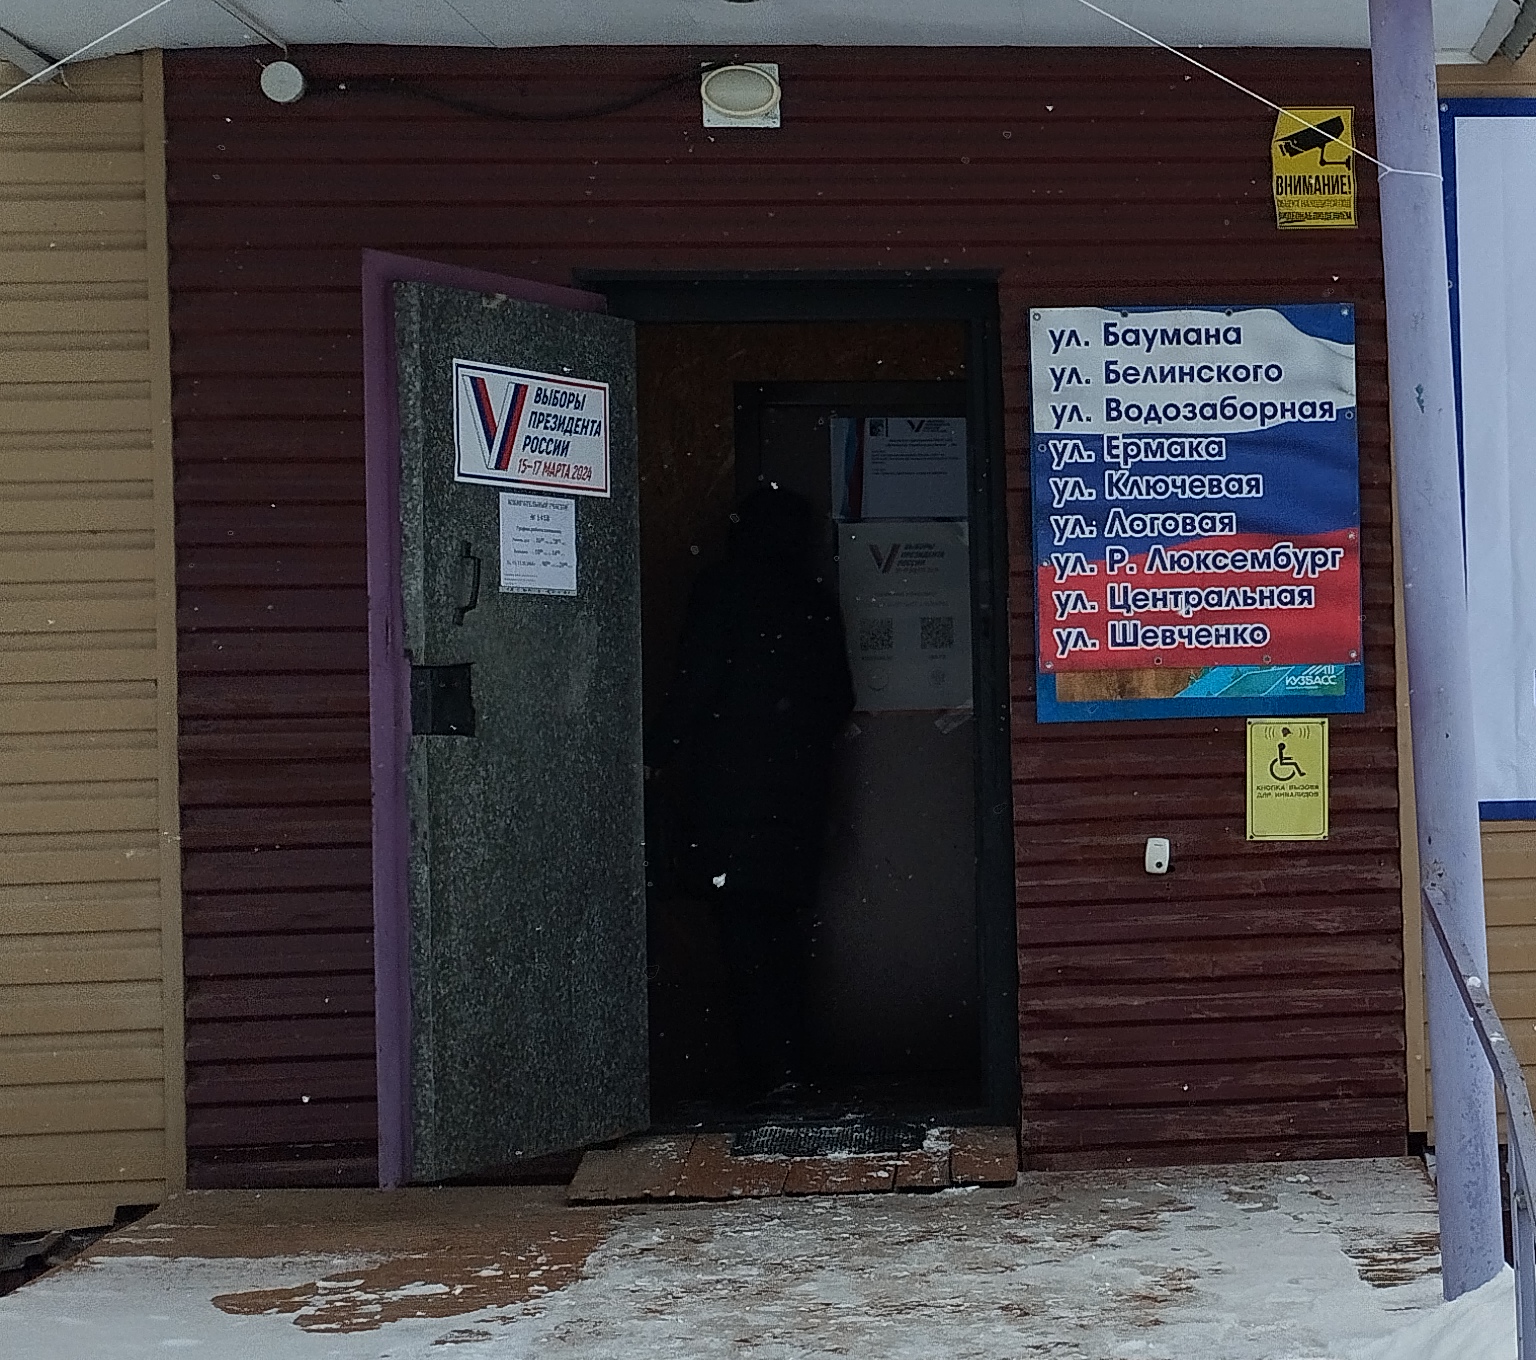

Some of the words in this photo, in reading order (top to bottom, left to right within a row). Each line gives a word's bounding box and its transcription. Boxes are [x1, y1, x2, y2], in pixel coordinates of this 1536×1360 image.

[1276, 175, 1351, 195] ВНИМАНИЕ!
[1049, 328, 1090, 354] ул.
[1103, 322, 1241, 354] Баумана
[1049, 366, 1091, 391] ул.
[1104, 360, 1282, 384] Белинского
[534, 387, 586, 411] ВЫБОРЫ
[1050, 404, 1092, 430] ул.
[1105, 398, 1335, 428] Водозаборная
[528, 411, 601, 437] ПРЕЗИДЕНТА
[522, 435, 571, 457] РОССИИ
[1050, 440, 1094, 467] ул.
[1104, 437, 1226, 467] Ермака
[542, 461, 570, 479] МАРТА
[572, 464, 592, 481] 2024
[1051, 477, 1095, 505] ул.
[1106, 471, 1262, 499] Ключевая
[1051, 513, 1096, 542] ул.
[1105, 510, 1236, 536] Логовая
[1052, 551, 1096, 579] ул.
[1108, 549, 1137, 573] Р.
[1146, 545, 1343, 578] Люксембург
[1053, 590, 1097, 620] ул.
[1108, 584, 1314, 613] Центральная
[1054, 628, 1098, 657] ул.
[1109, 623, 1269, 648] Шевченко
